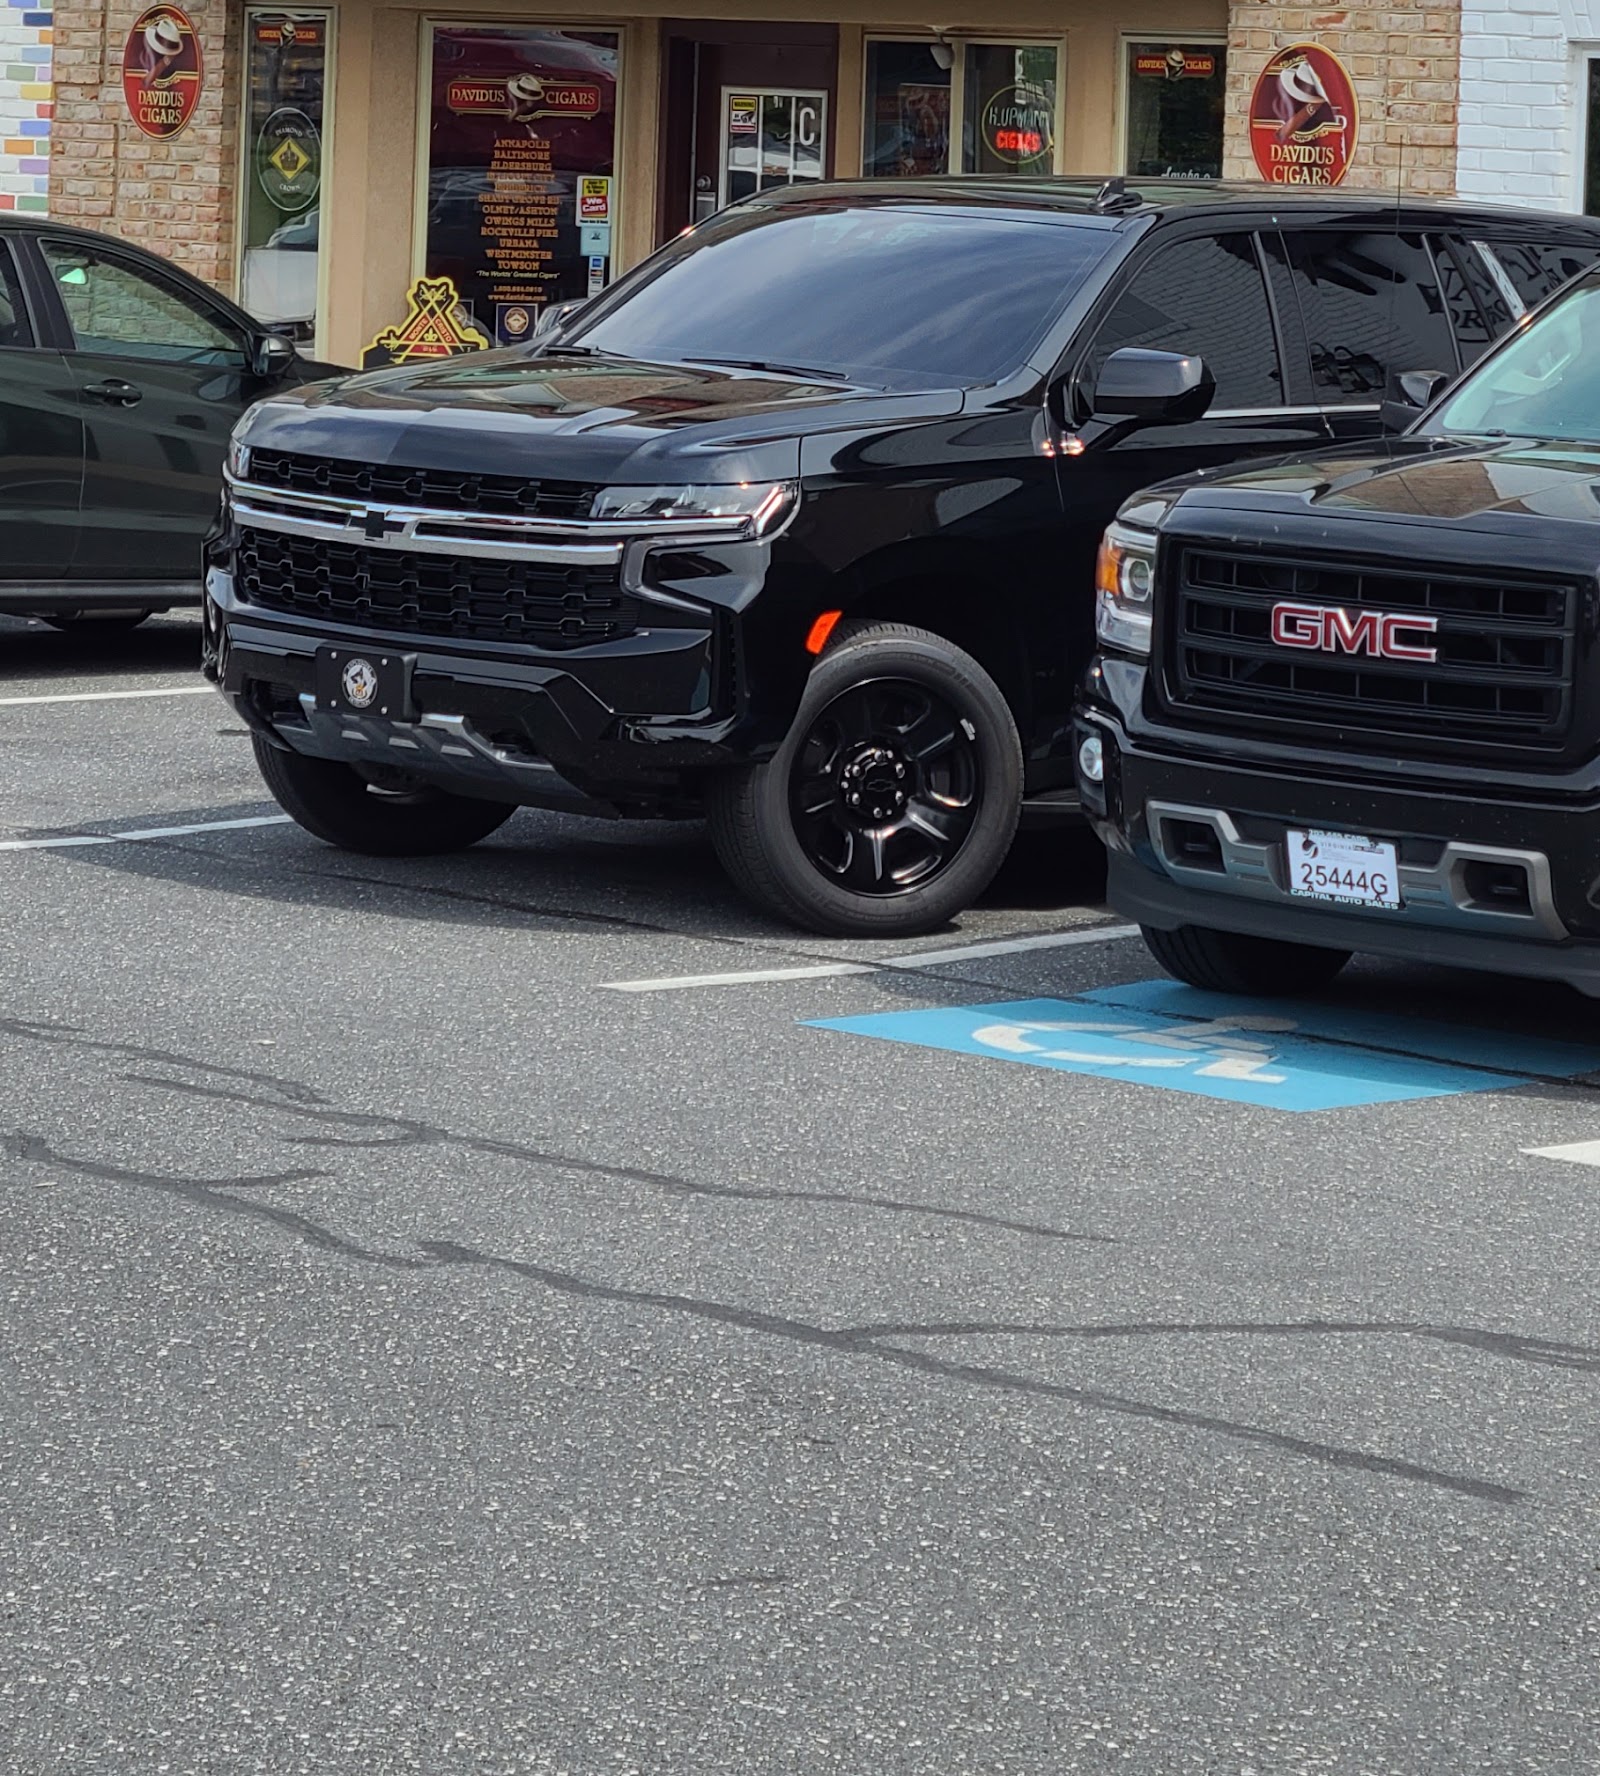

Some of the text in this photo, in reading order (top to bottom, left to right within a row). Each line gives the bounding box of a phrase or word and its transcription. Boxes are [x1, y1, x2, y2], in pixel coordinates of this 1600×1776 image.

[1138, 59, 1212, 70] DAVIDUS CIGARS
[137, 89, 184, 108] DAVIDUS
[451, 88, 595, 105] DAVIDUS CIGARS
[139, 107, 182, 124] CIGARS
[275, 127, 303, 137] DIAMOND
[799, 107, 816, 146] C
[494, 139, 550, 149] ANNAPOLIS
[494, 150, 550, 160] BALTIMORE
[1270, 144, 1335, 165] DAVIDUS
[491, 161, 552, 171] ELDERSBURG
[1272, 166, 1332, 185] CIGARS
[280, 184, 301, 192] CROWN
[586, 197, 603, 205] We
[582, 203, 606, 212] Card
[484, 216, 556, 227] OWINGS MILLS
[481, 227, 558, 238] ROCKVILLE PIKE
[499, 238, 539, 248] URBANA
[485, 249, 553, 259] WESTMINSTER
[497, 260, 540, 270] TOWSON
[409, 317, 453, 343] MONTE CRISTO
[1271, 601, 1439, 664] GMC
[1301, 863, 1388, 896] 25444G
[1290, 888, 1399, 910] CAPITAL AUTO SALES
